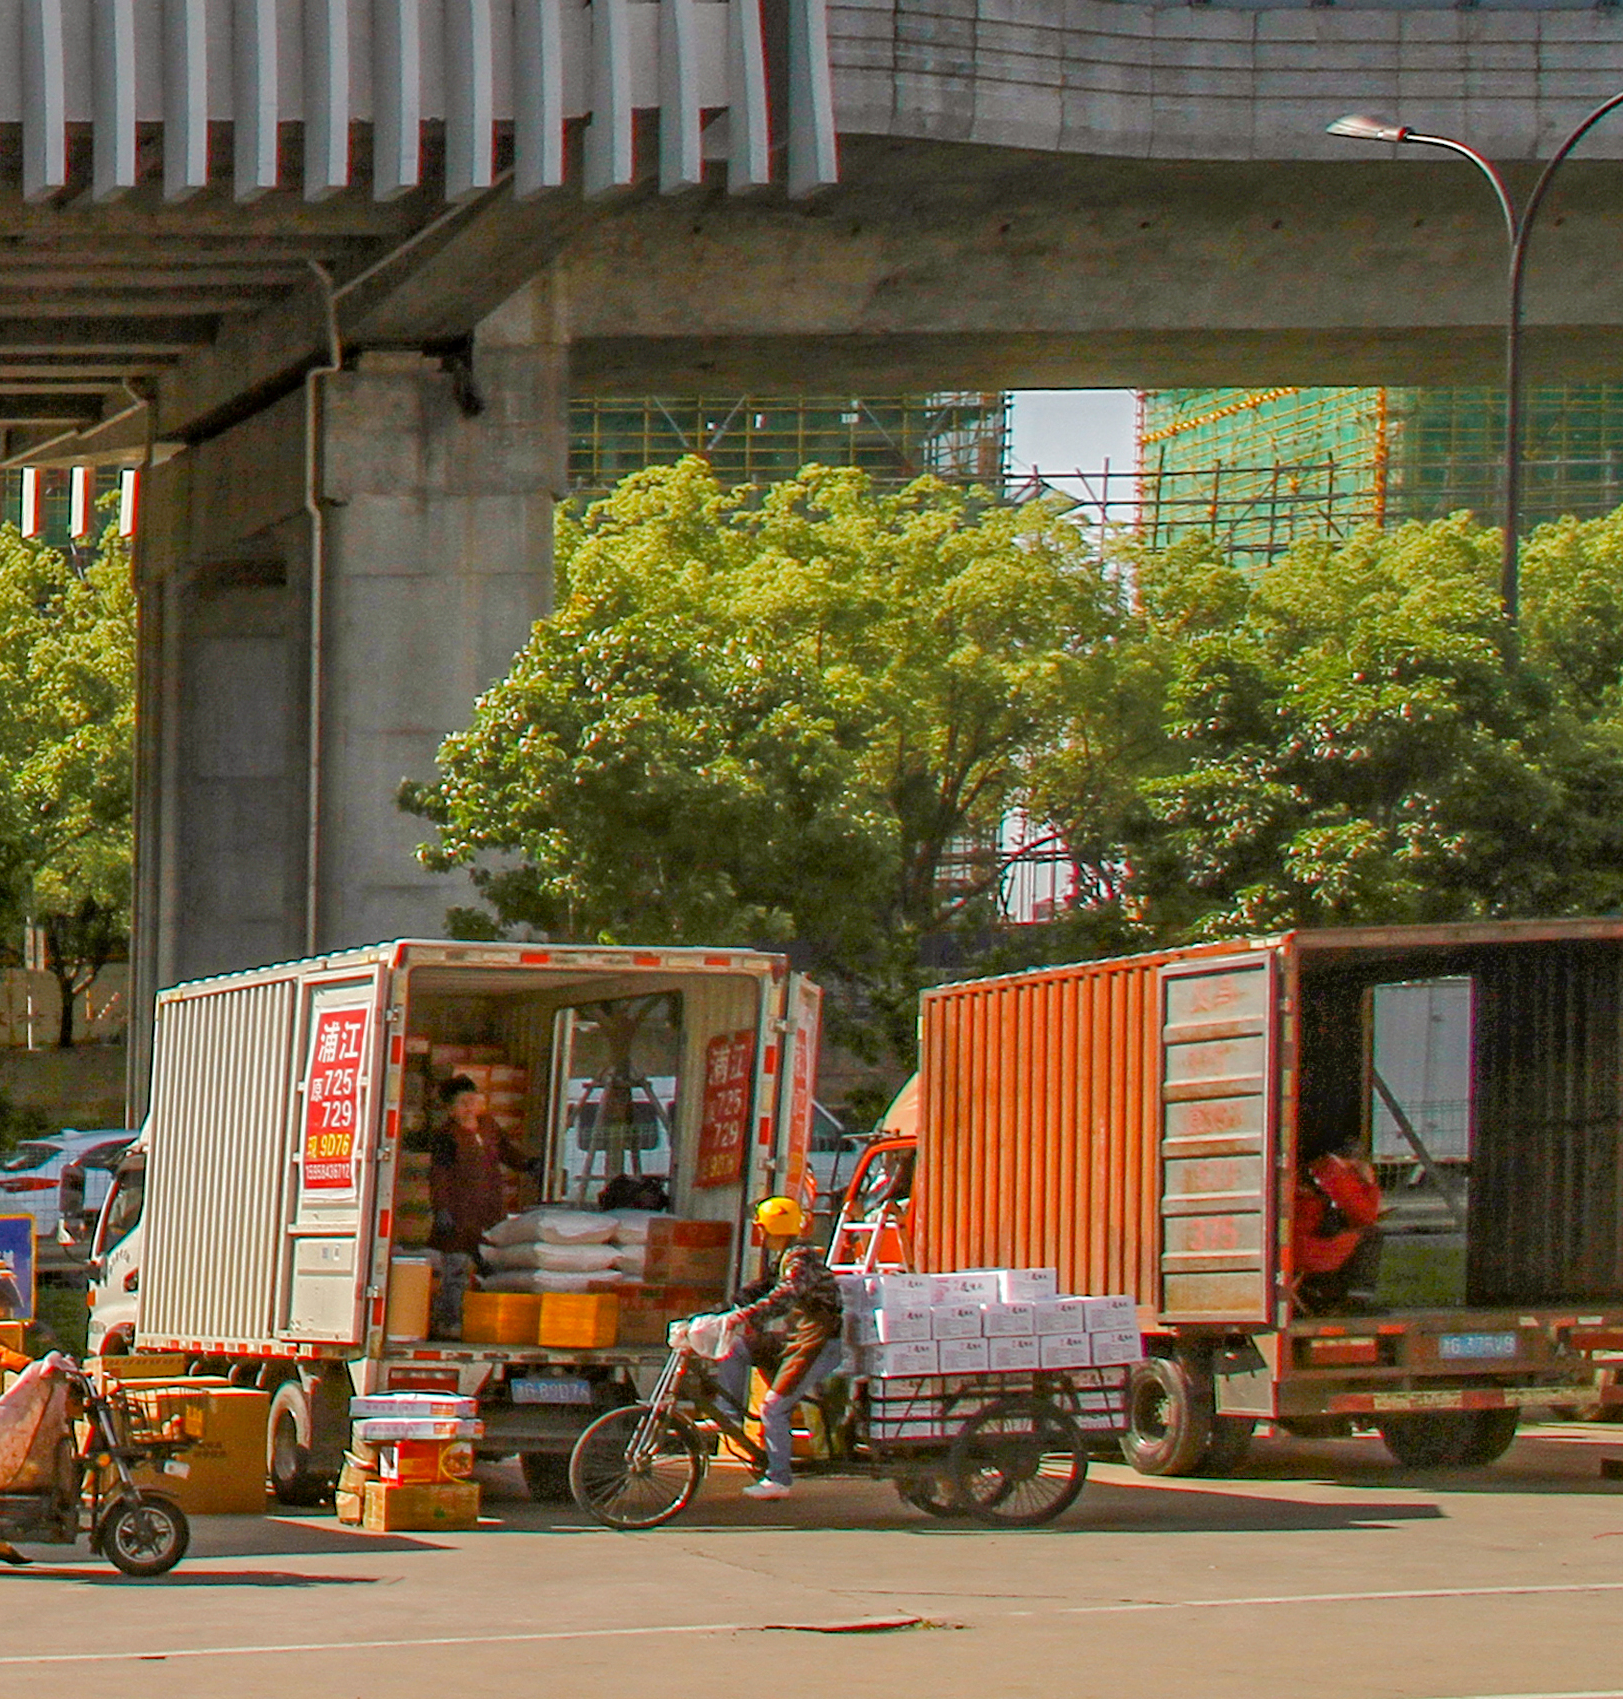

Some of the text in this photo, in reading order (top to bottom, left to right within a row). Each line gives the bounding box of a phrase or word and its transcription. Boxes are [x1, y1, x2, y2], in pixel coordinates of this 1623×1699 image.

[318, 1021, 361, 1063] 浦江
[324, 1069, 354, 1096] 725
[322, 1100, 352, 1128] 729
[320, 1134, 351, 1157] 9D76
[715, 1121, 739, 1147] 729
